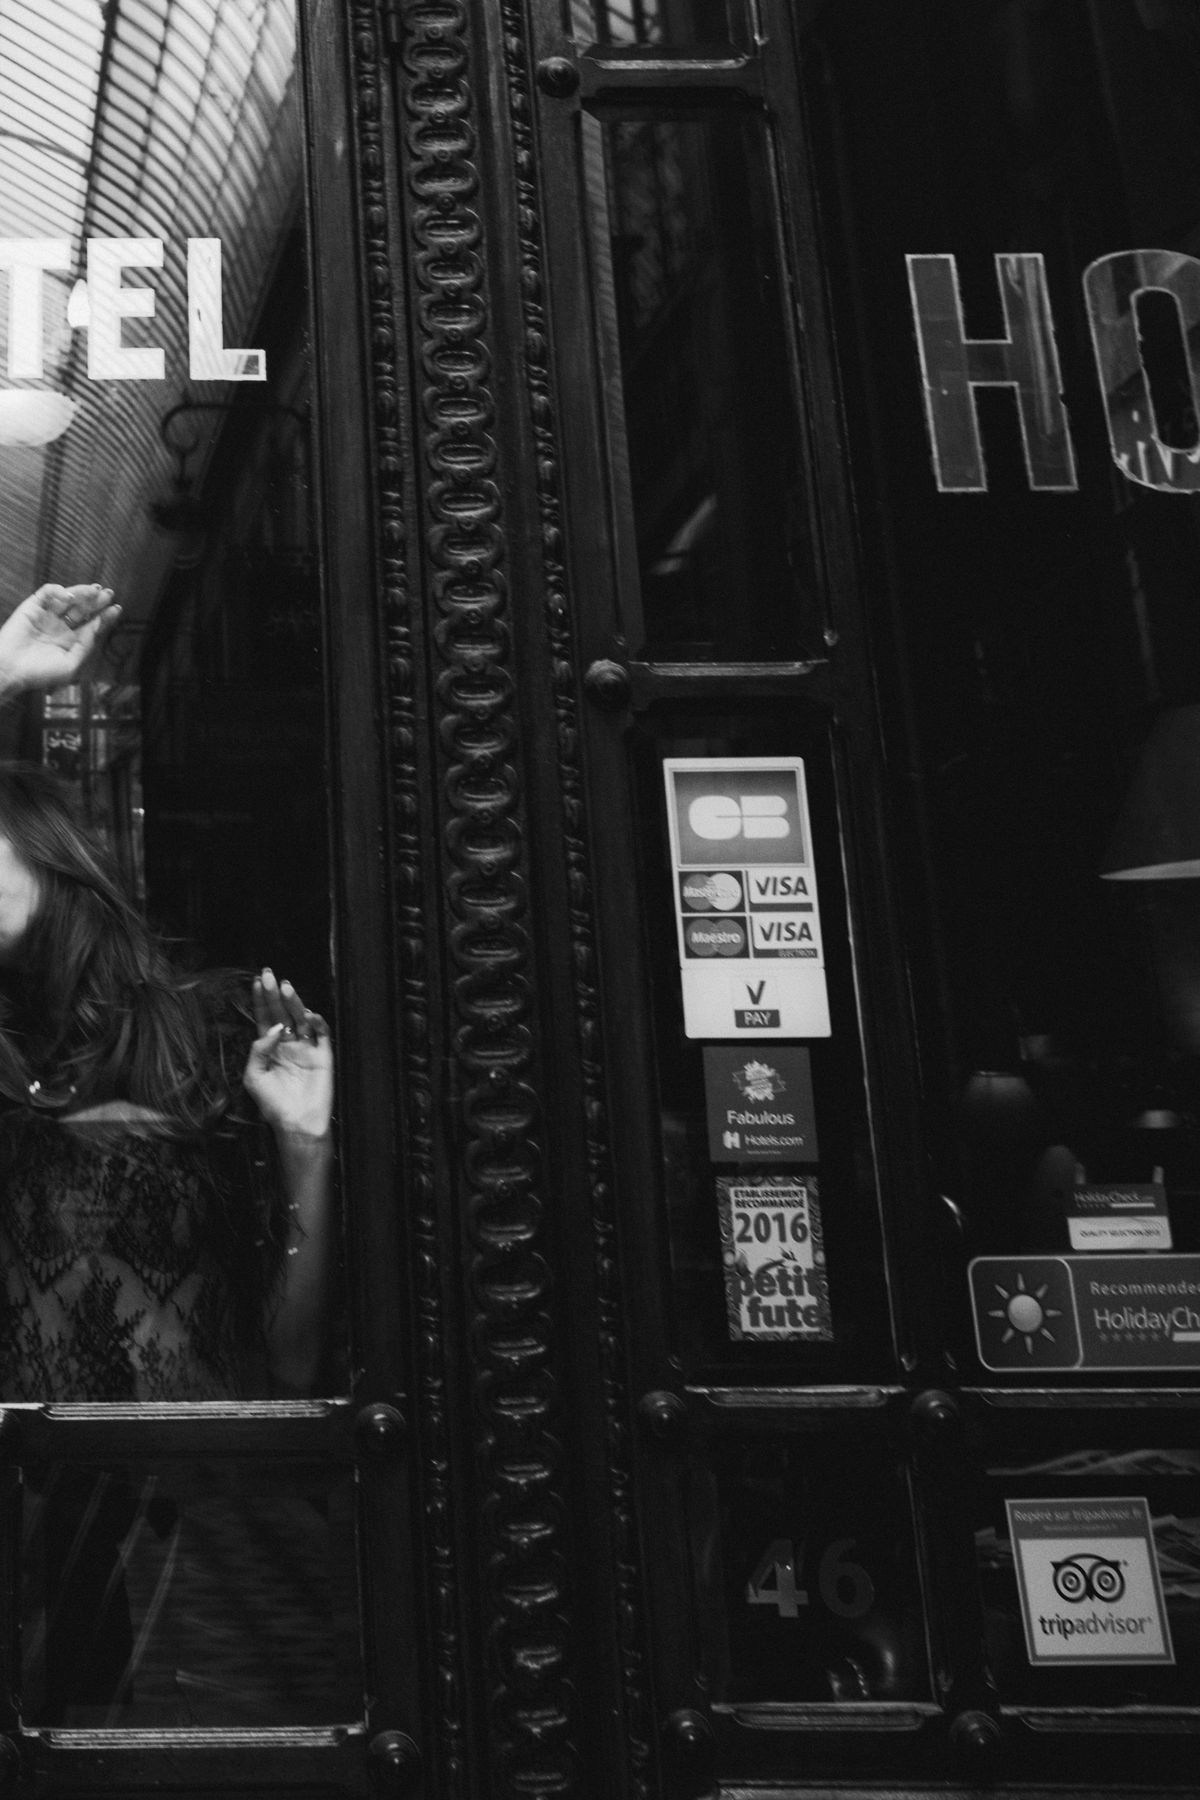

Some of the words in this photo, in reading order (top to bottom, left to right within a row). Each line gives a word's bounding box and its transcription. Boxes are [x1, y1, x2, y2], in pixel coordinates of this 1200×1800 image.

[688, 795, 790, 840] CB
[755, 876, 809, 897] VISA
[691, 931, 741, 944] Maestro
[759, 922, 813, 942] VISA
[745, 980, 766, 1005] V
[744, 1011, 771, 1026] PAY
[726, 1109, 796, 1125] Fabulous
[744, 1134, 804, 1146] Hotels.com
[734, 1212, 809, 1244] 2016
[746, 1538, 875, 1619] 46
[1038, 1611, 1146, 1641] tripadvisor
